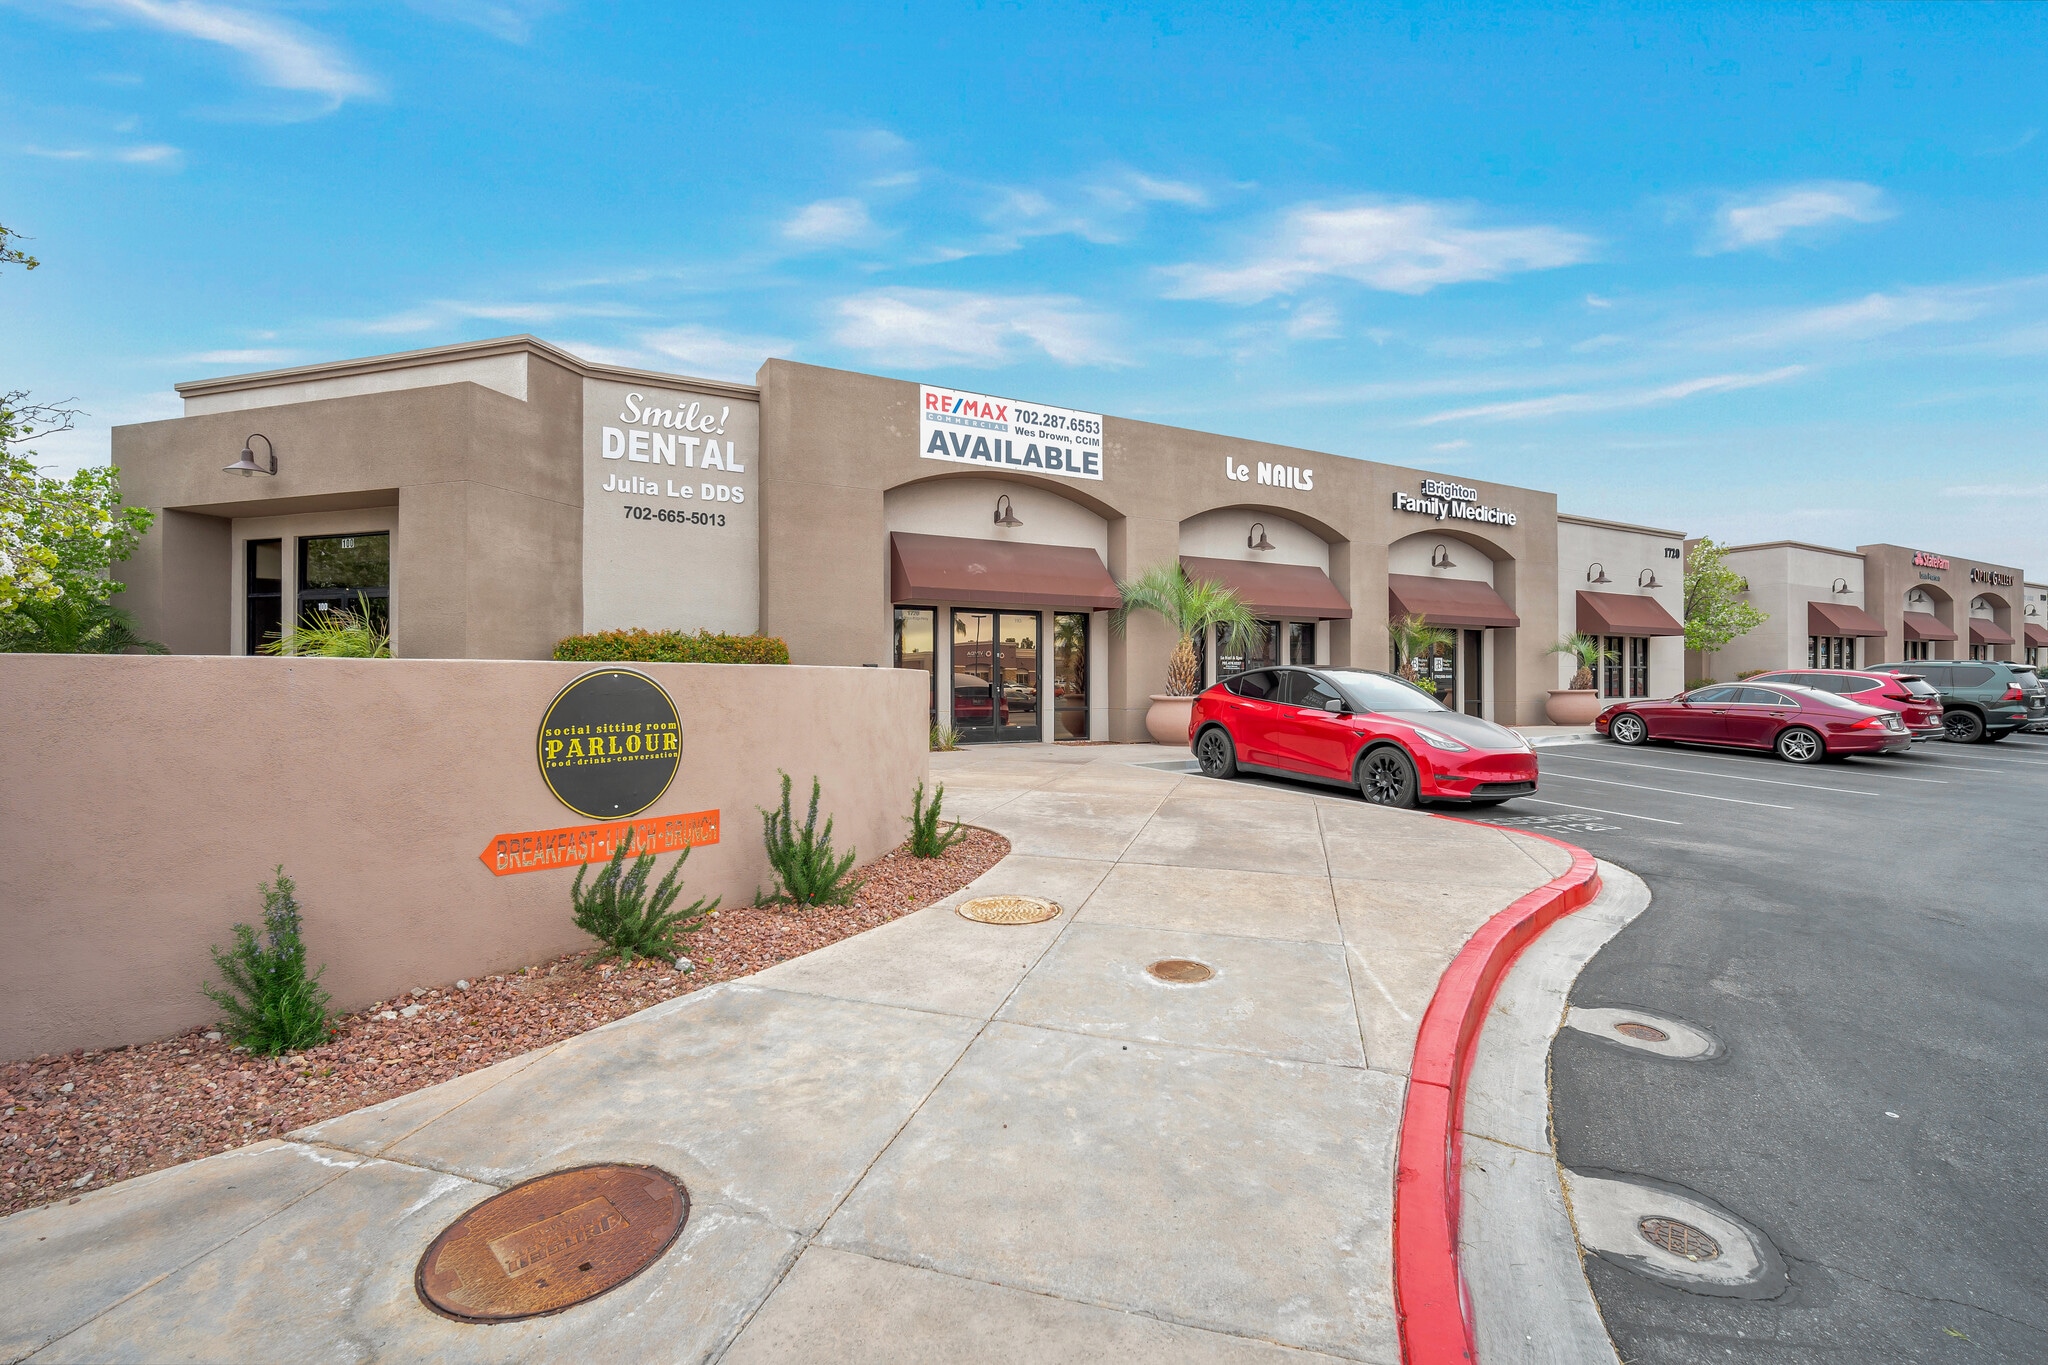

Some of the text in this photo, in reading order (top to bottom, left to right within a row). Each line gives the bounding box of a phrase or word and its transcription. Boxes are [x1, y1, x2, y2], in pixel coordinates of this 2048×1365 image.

[619, 392, 729, 435] Smile!
[925, 392, 1008, 422] RE/MAX
[928, 413, 1007, 431] COMMERCIAL
[1014, 408, 1100, 435] 702.287.6553
[602, 426, 745, 473] DENTAL
[1014, 426, 1100, 447] Wes Drown, CCIM
[927, 429, 1099, 475] AVAILABLE
[1226, 456, 1314, 491] Le NAILS
[602, 474, 745, 504] Julia Le DDS
[1425, 480, 1477, 501] Brighton
[623, 505, 726, 527] 702-665-5013
[1396, 492, 1517, 526] Family Medicine
[341, 538, 354, 549] 100
[1664, 547, 1680, 559] 1720
[545, 722, 677, 737] social sitting room
[546, 732, 677, 759] PARLOUR
[546, 751, 678, 768] food-drinks-conversation
[496, 830, 598, 870] BREAKFAST
[665, 816, 717, 847] BRUNCH
